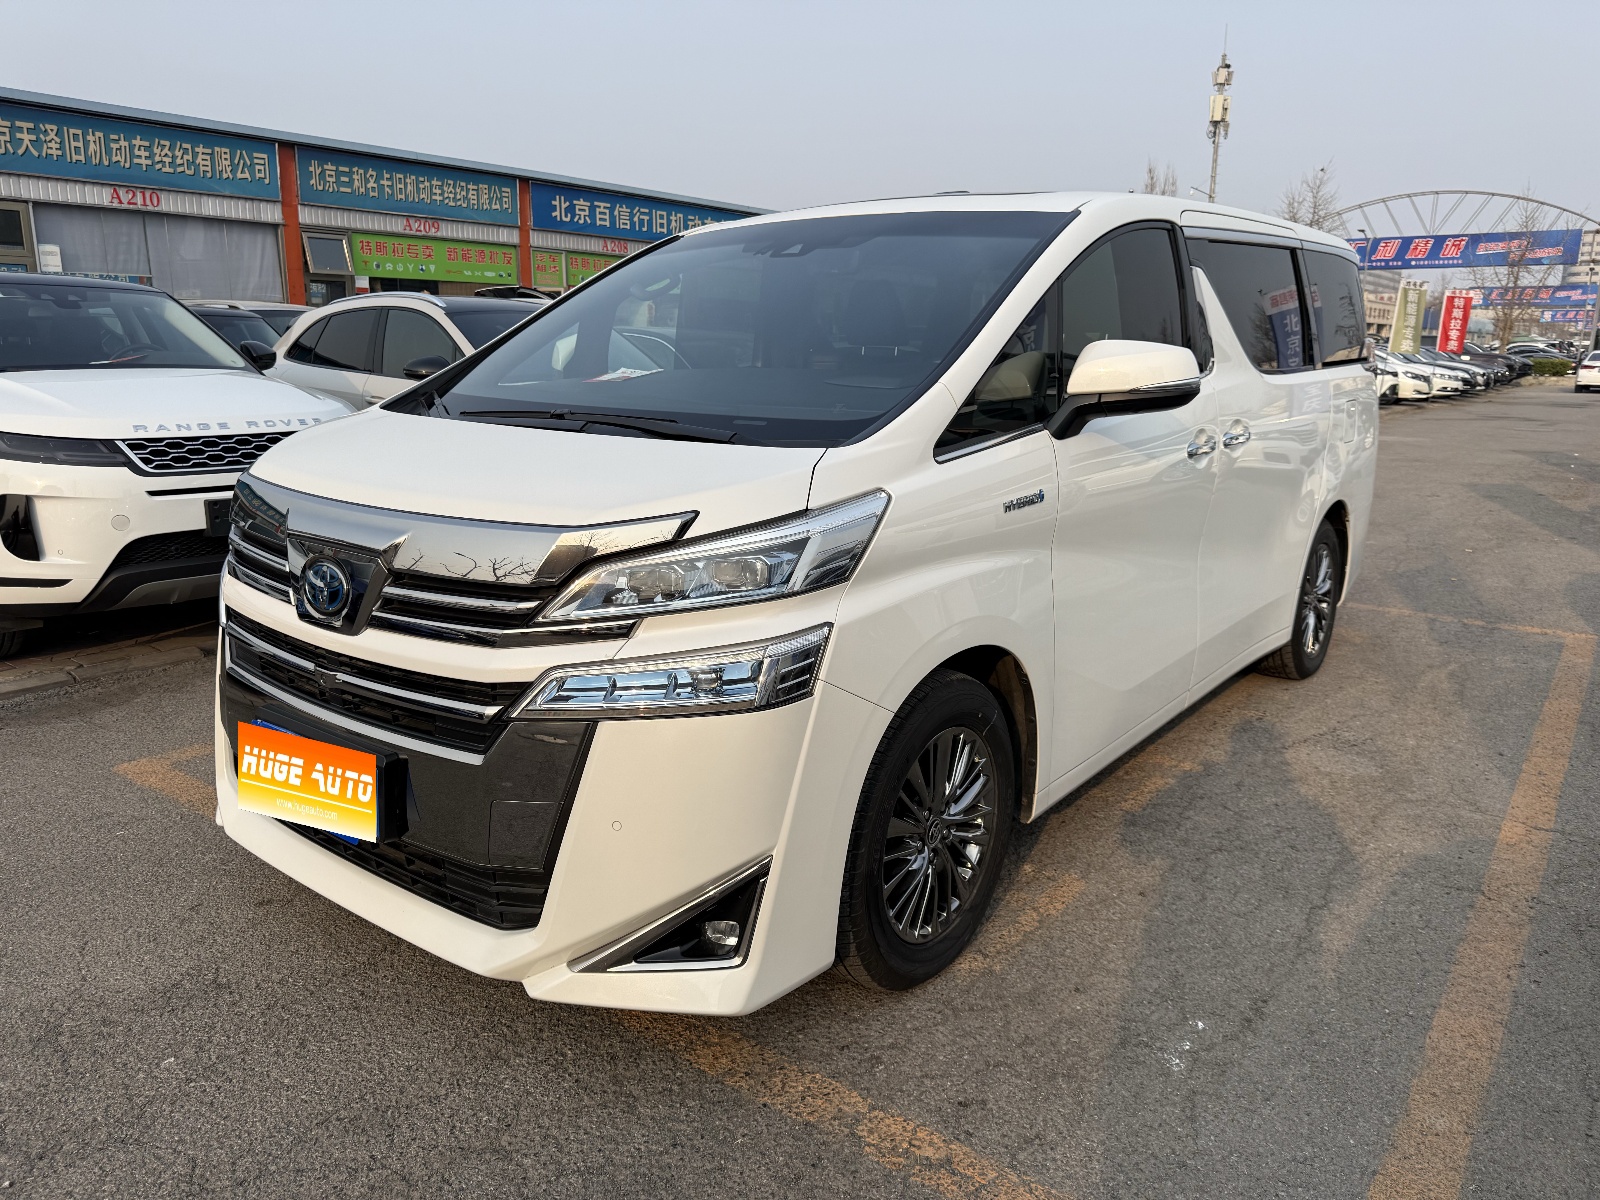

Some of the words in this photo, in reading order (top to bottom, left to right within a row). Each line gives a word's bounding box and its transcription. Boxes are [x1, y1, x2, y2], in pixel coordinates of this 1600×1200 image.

[308, 159, 513, 214] 北京三和名卡旧机动车经纪有限公司
[109, 187, 160, 208] A210
[403, 217, 440, 234] A209
[359, 239, 435, 260] 特斯拉专卖
[446, 247, 513, 266] 新能源批发
[602, 239, 629, 254] A208
[132, 422, 230, 433] RANGE
[245, 418, 322, 428] ROVER
